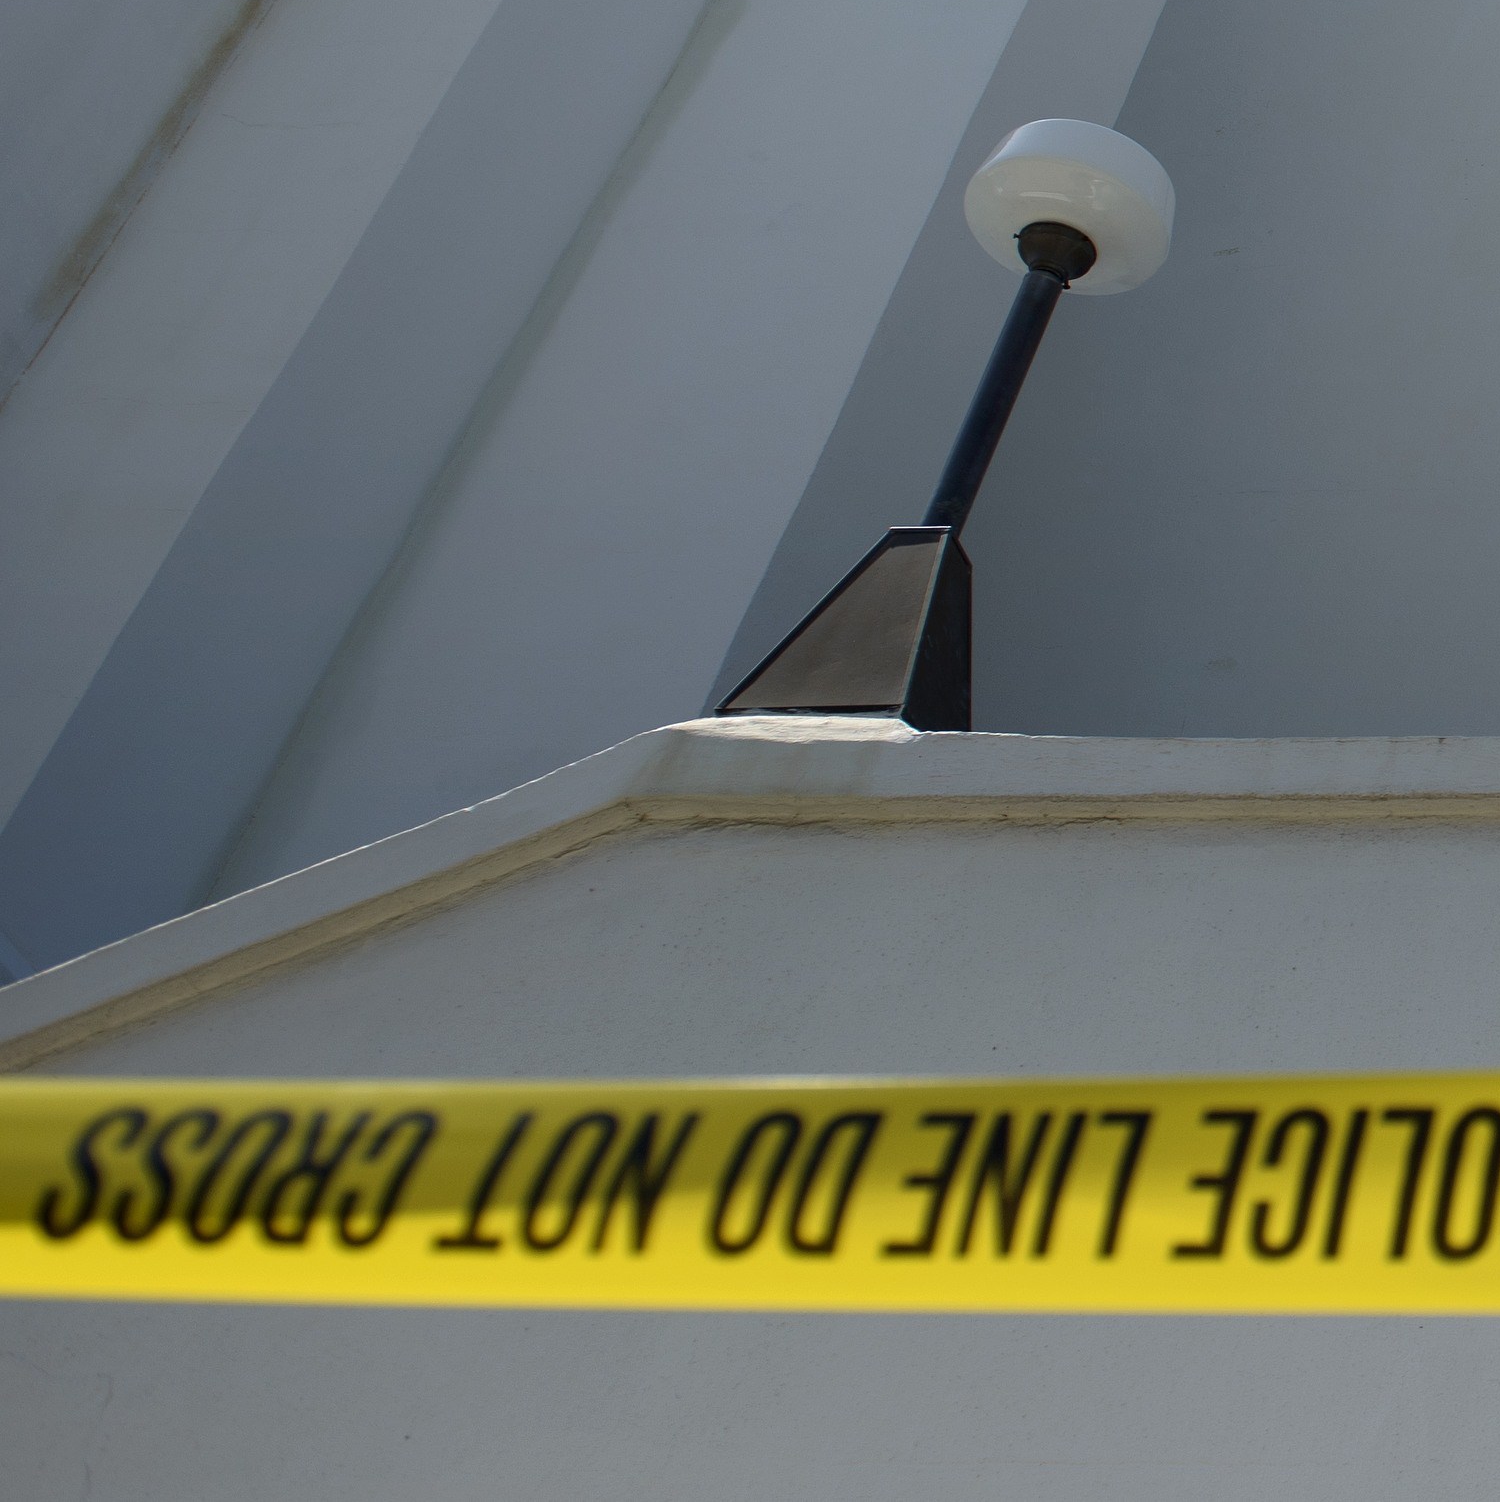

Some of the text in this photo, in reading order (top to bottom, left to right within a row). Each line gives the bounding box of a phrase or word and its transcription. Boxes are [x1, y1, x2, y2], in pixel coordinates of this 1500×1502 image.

[36, 1106, 440, 1251] CROSS
[430, 1111, 702, 1256] NOT
[709, 1110, 885, 1258] DO
[879, 1110, 1154, 1260] LINE
